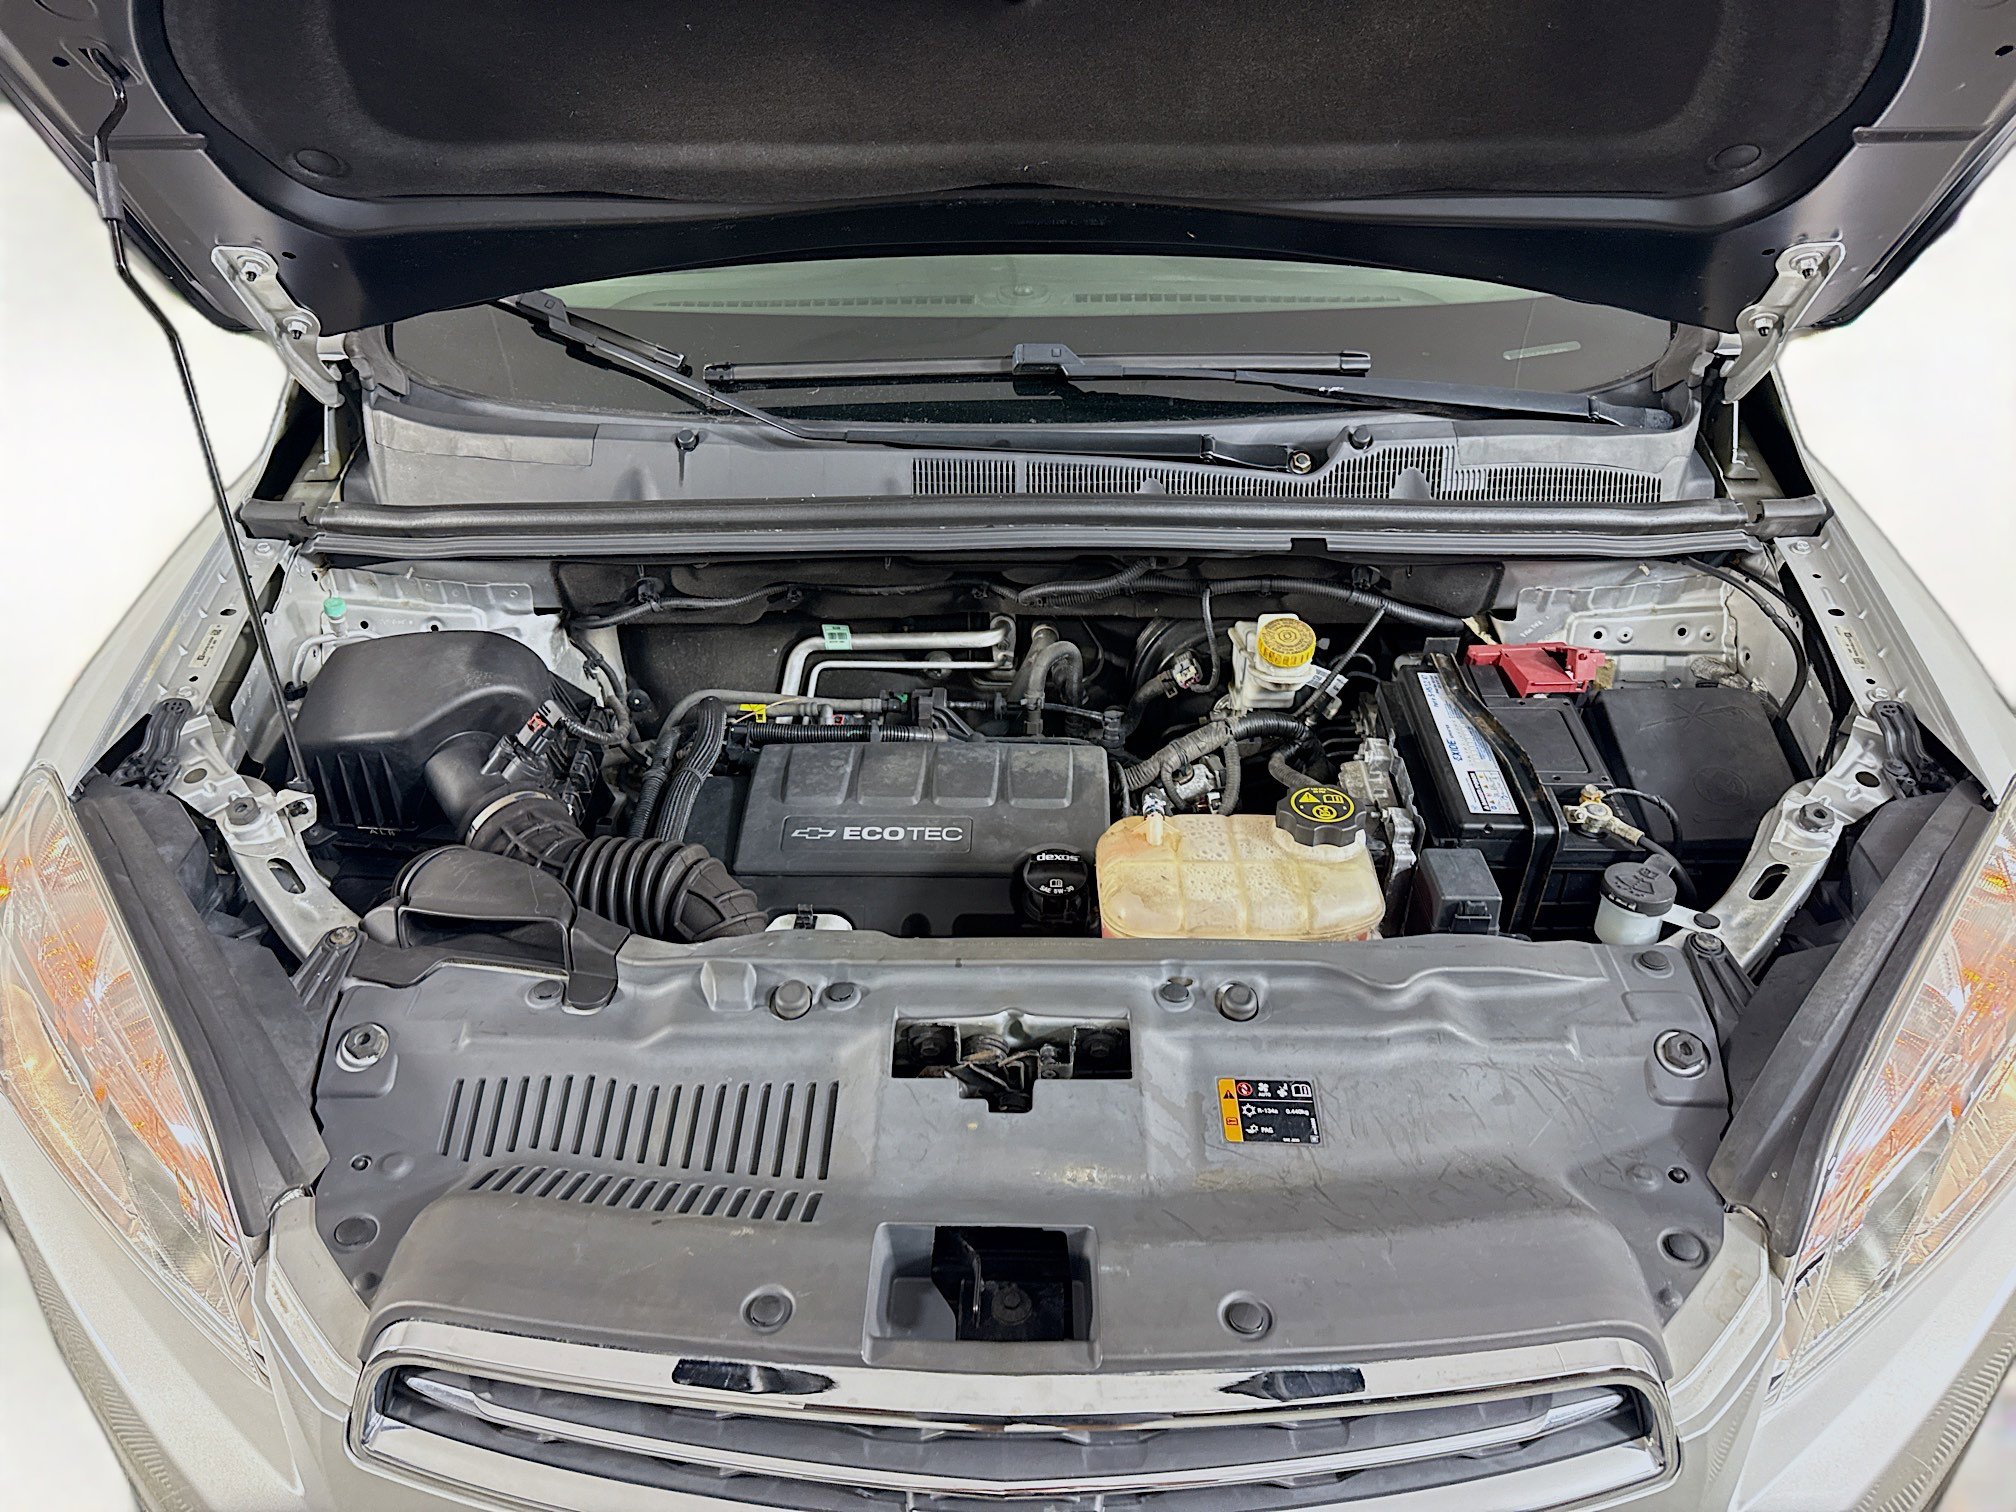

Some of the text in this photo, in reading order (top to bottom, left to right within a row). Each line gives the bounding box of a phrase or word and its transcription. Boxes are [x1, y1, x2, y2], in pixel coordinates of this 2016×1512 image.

[843, 826, 963, 842] ECOTEC
[1036, 852, 1079, 862] dexos
[1039, 885, 1052, 894] SAE
[1260, 1126, 1274, 1134] PAG
